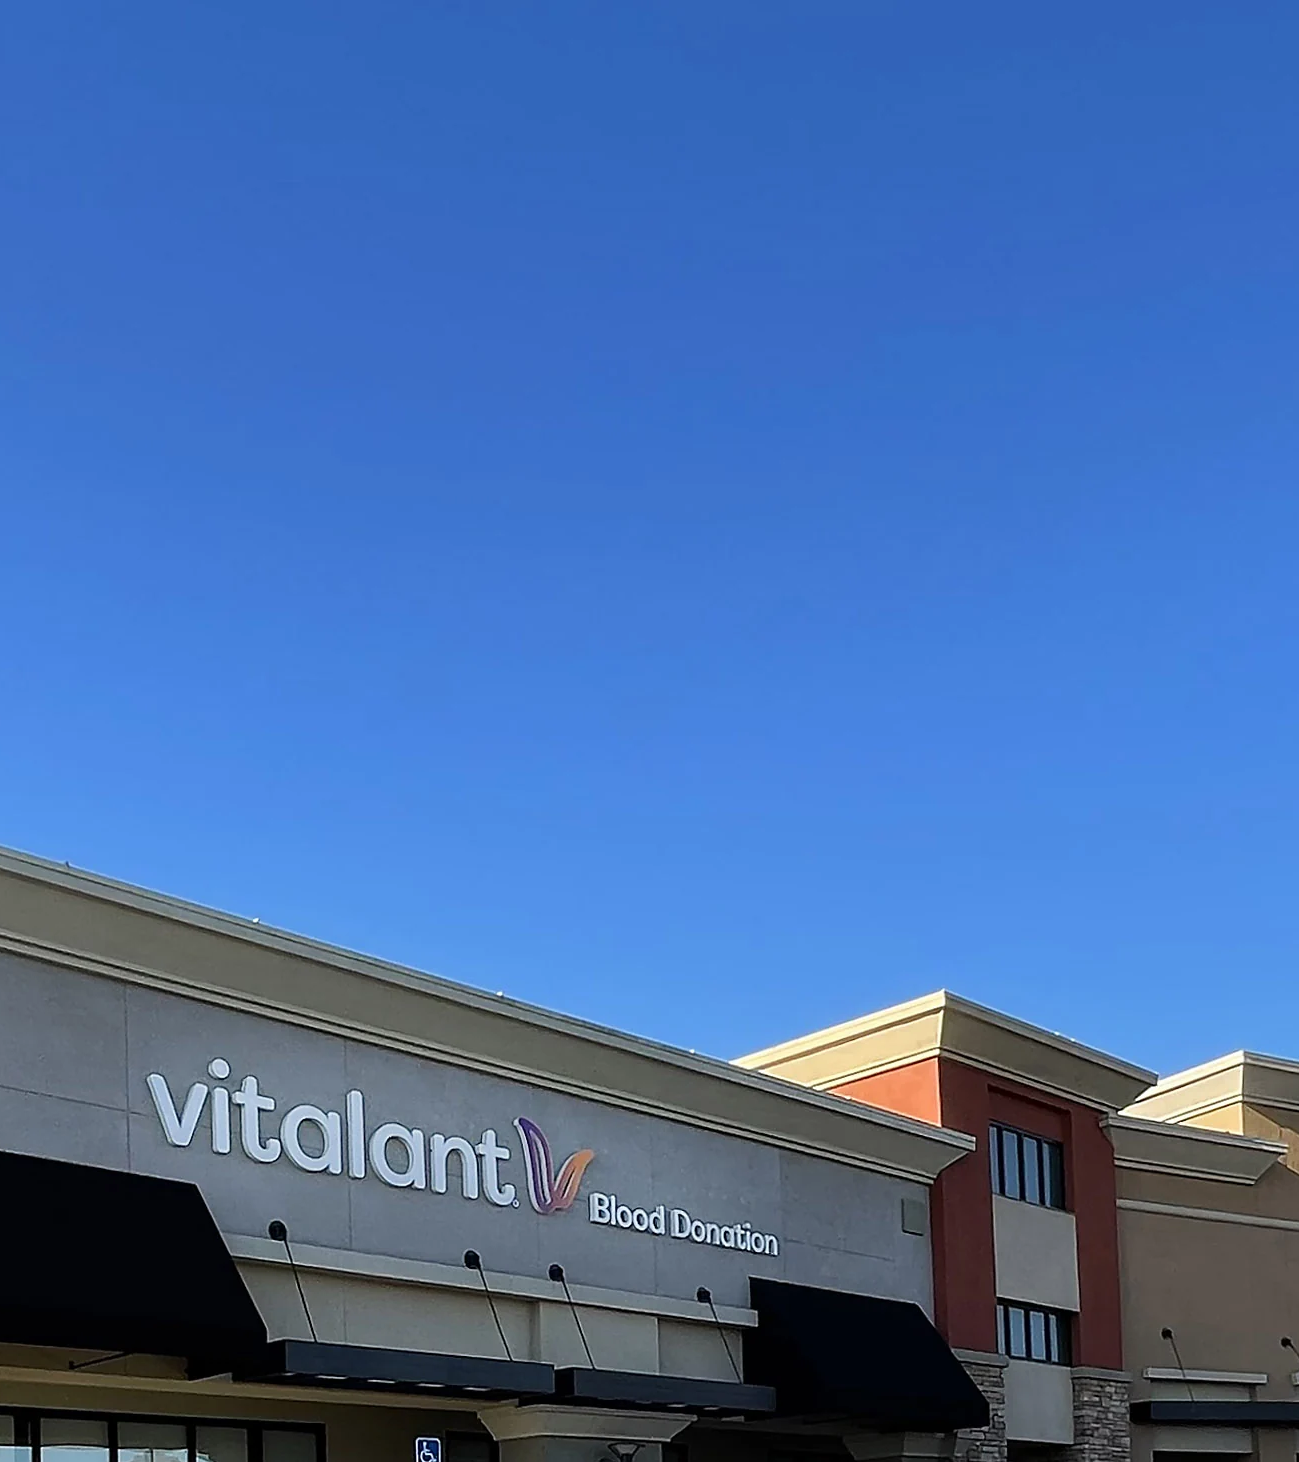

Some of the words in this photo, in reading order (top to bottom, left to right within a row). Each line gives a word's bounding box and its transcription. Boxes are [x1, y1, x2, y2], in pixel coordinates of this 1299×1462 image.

[145, 1057, 517, 1207] vitalant
[589, 1192, 666, 1235] Blood
[670, 1208, 779, 1256] Donation
